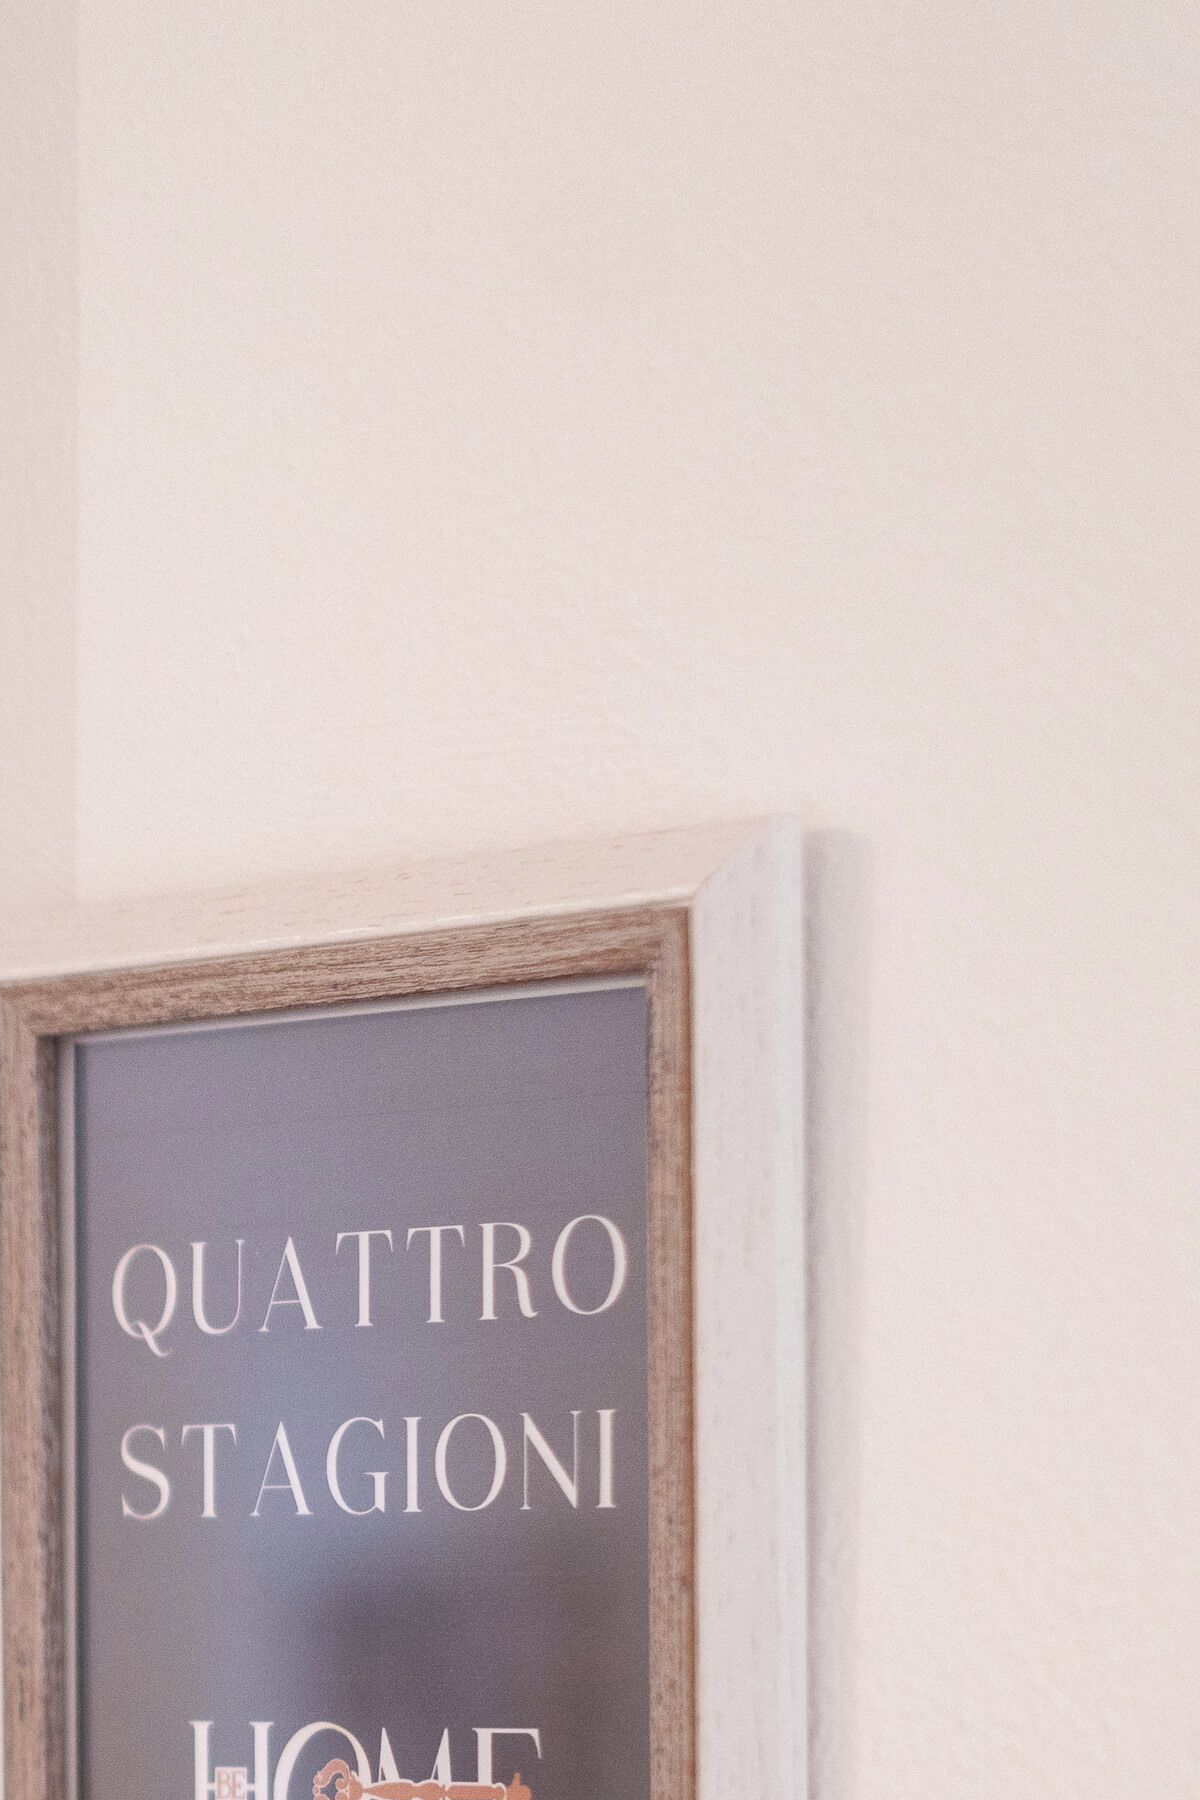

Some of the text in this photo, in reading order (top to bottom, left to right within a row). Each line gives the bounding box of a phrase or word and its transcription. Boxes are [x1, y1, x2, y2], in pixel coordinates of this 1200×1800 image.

[111, 1214, 628, 1357] QUATTRO
[119, 1408, 618, 1520] STAGIONI
[215, 1769, 247, 1800] BE
